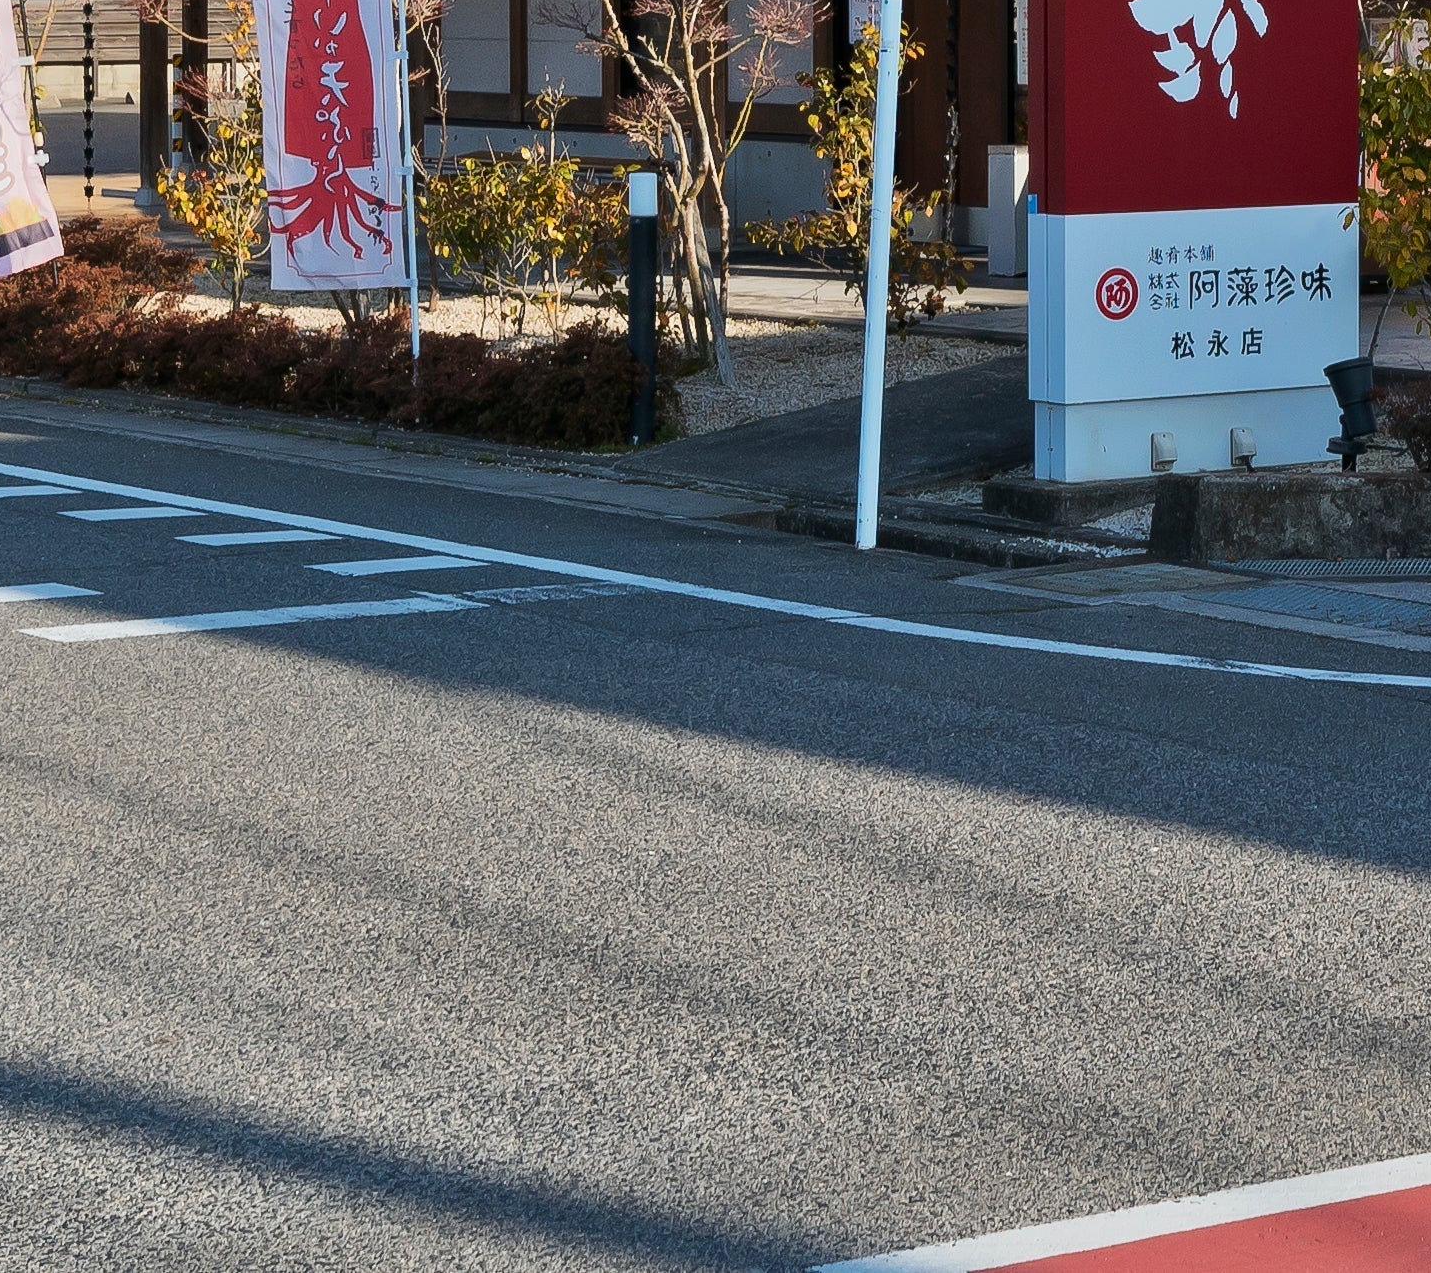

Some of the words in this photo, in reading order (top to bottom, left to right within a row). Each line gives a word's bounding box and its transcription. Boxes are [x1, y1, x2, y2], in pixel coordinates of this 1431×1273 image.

[1189, 262, 1332, 310] 阿藻珍味
[1171, 328, 1263, 360] 松永店
